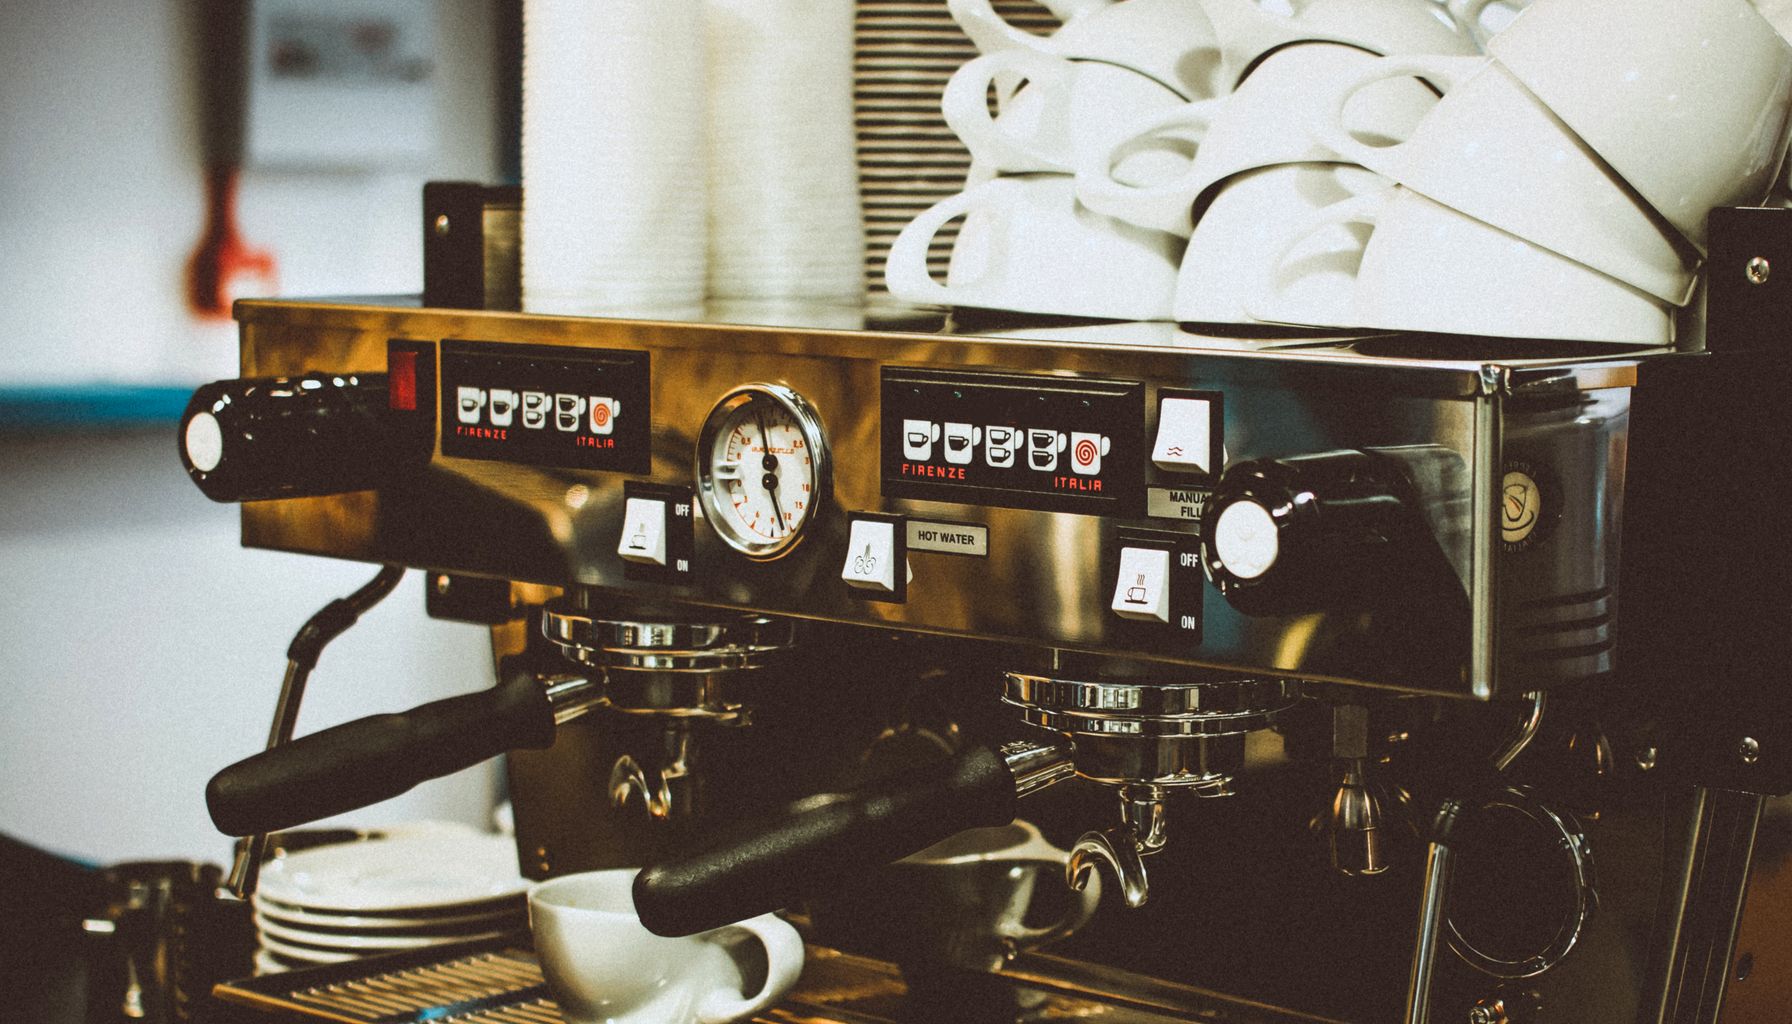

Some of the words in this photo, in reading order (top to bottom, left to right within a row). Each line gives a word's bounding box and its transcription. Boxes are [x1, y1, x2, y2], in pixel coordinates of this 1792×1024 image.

[456, 426, 507, 440] FIRENZE
[577, 437, 615, 448] ITALIA
[902, 463, 966, 480] FIRENZE
[1054, 476, 1102, 491] ITALIA
[1170, 491, 1208, 504] MANUA
[675, 504, 690, 517] OFF
[1181, 506, 1201, 518] FILL
[918, 530, 938, 543] HOT
[941, 532, 975, 546] WATER
[677, 559, 689, 572] ON
[1180, 553, 1199, 568] OFF
[1181, 616, 1195, 630] ON
